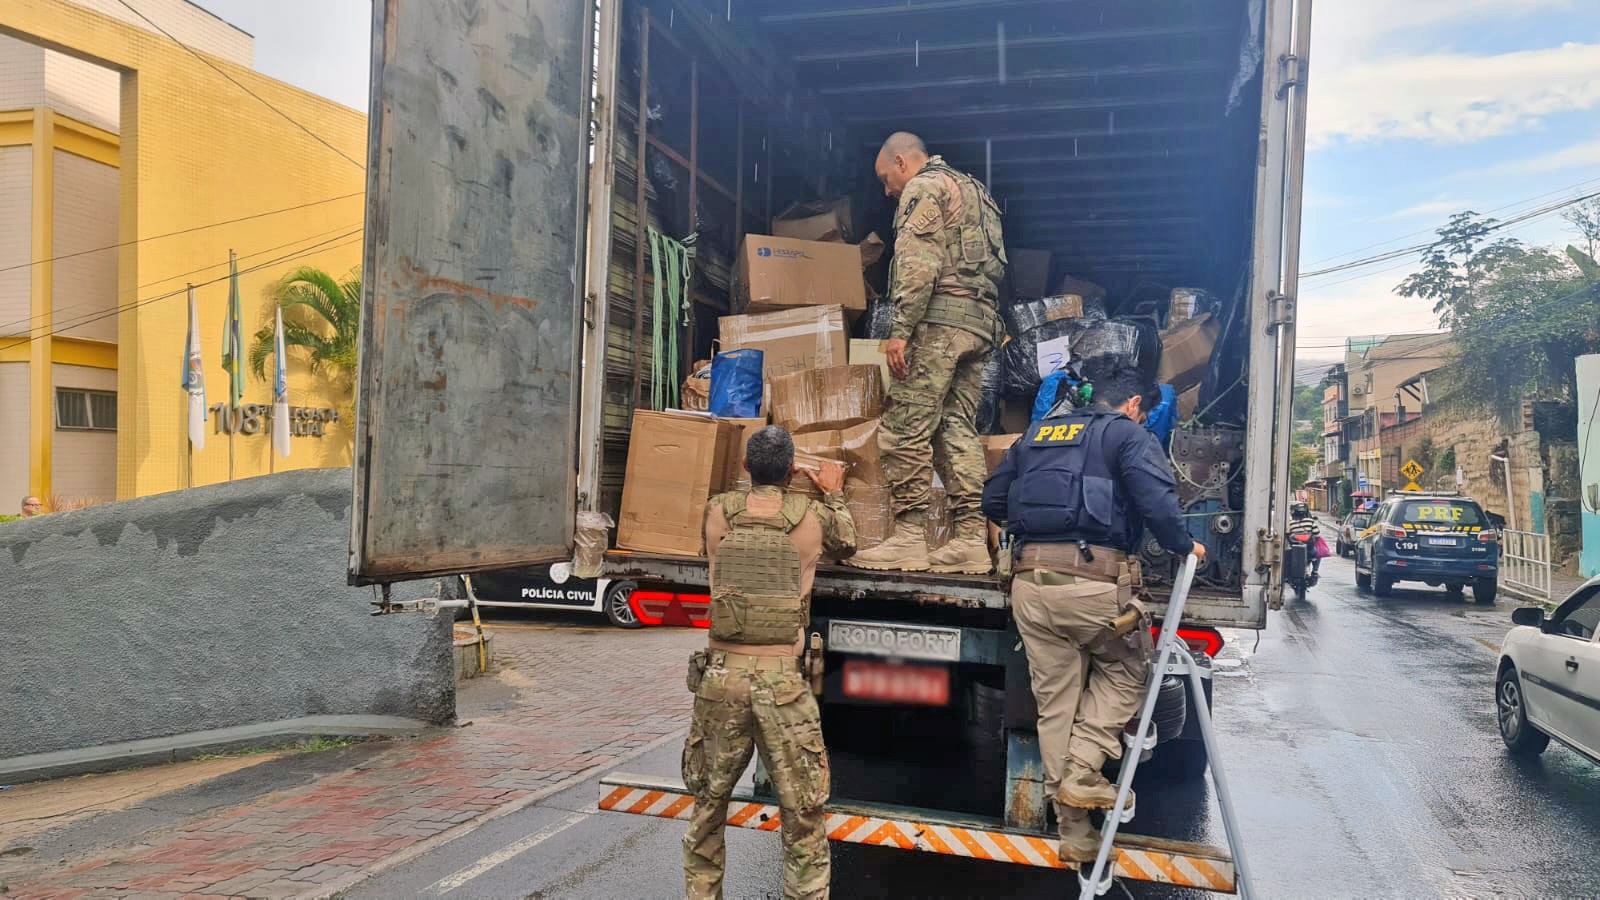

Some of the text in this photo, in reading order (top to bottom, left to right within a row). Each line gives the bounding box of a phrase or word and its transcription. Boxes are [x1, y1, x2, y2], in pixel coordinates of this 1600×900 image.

[1034, 423, 1084, 441] PRF
[1417, 506, 1463, 521] PRF
[1402, 542, 1418, 550] 191
[521, 587, 596, 601] POLÍCIA CIVIL
[836, 625, 954, 654] RODOFORT
